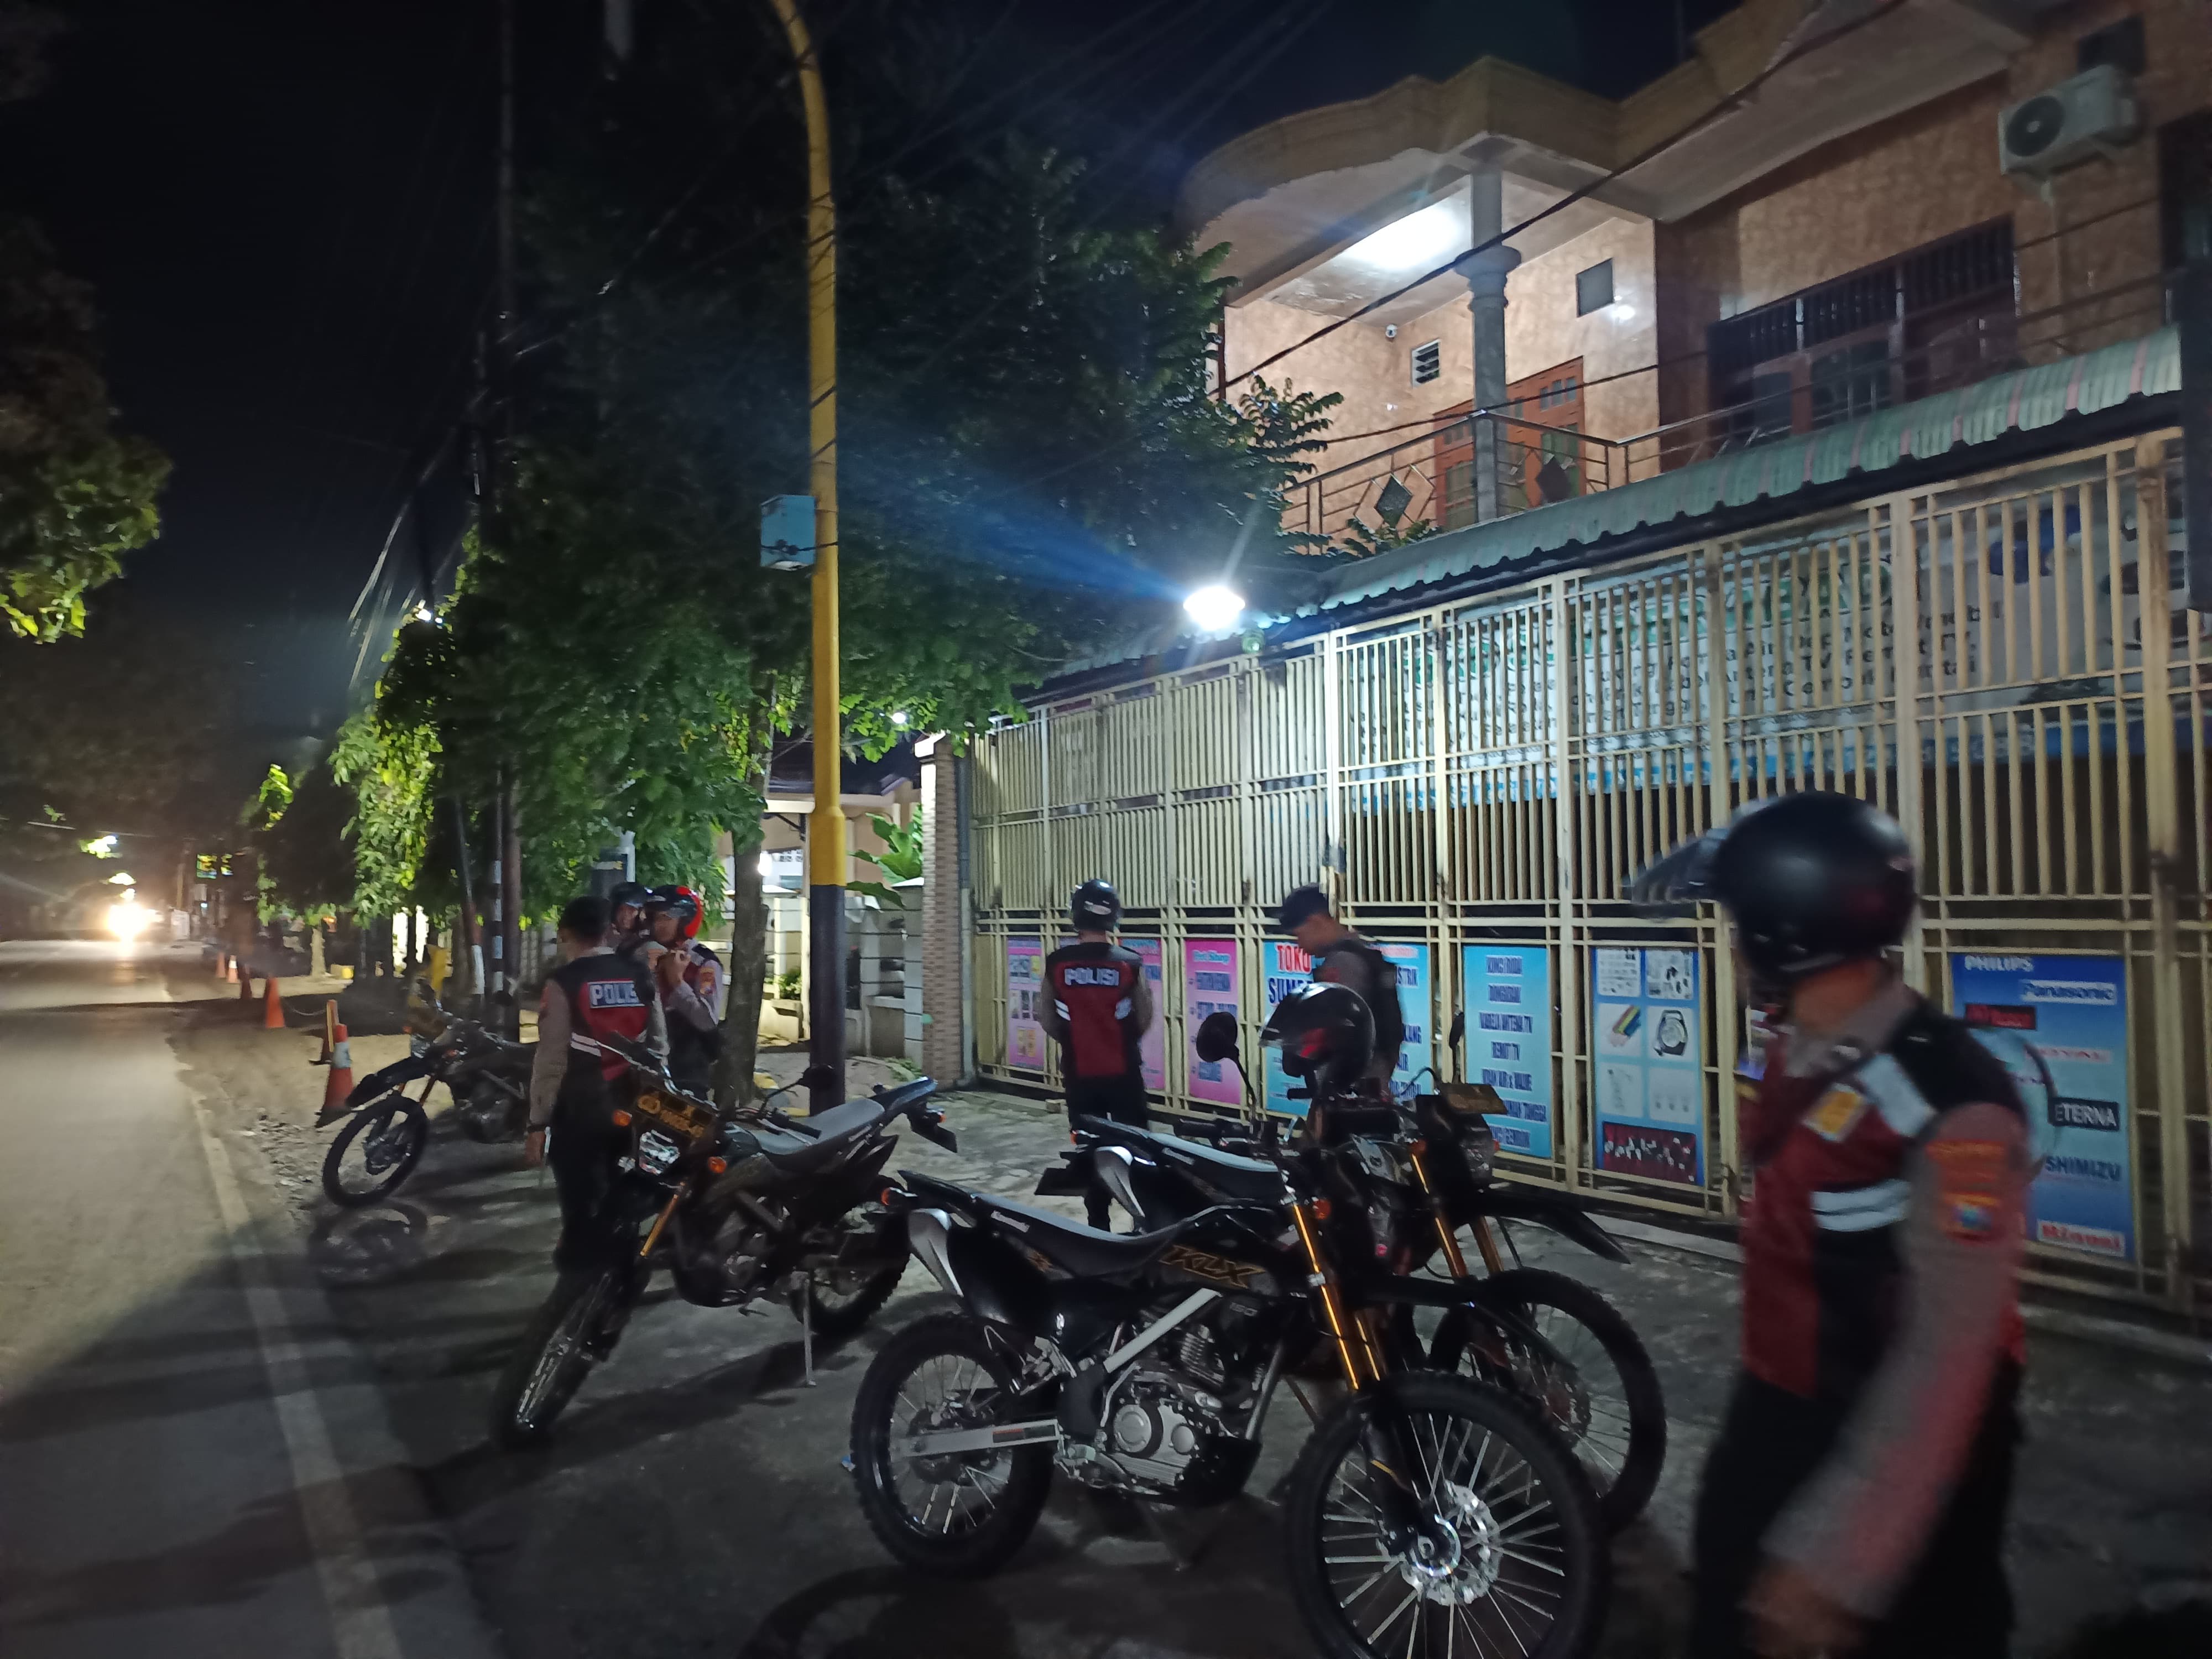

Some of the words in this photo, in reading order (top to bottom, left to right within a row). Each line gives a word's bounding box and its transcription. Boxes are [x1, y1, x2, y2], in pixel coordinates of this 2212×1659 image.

[1277, 944, 1311, 973] TOKO
[1964, 955, 2034, 972] PHILIPS
[1064, 967, 1119, 987] POLISI
[590, 983, 640, 1005] POLIS
[2054, 1102, 2118, 1128] ETERNA
[1160, 1244, 1267, 1290] KLX
